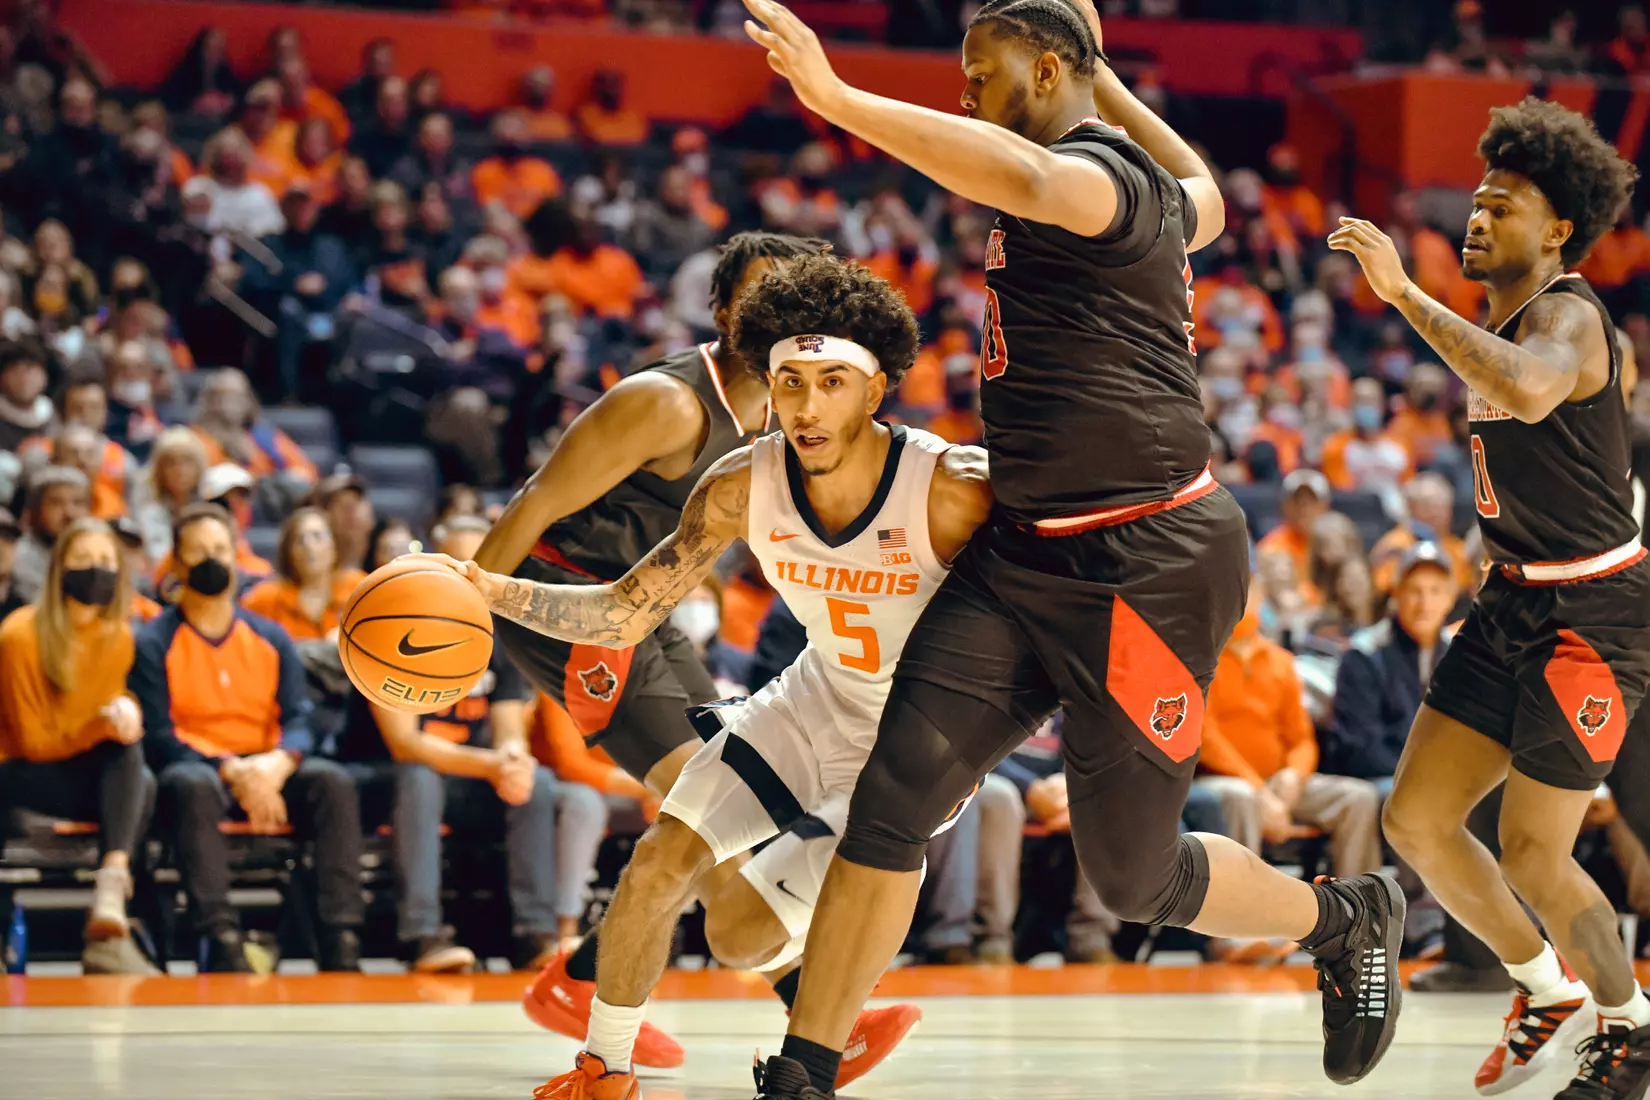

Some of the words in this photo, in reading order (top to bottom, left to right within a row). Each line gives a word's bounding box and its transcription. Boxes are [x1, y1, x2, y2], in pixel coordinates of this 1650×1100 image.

[776, 561, 920, 595] ILLINOIS
[826, 597, 880, 674] 5
[382, 677, 462, 703] ELITE
[1367, 948, 1386, 1018] ADVISORY
